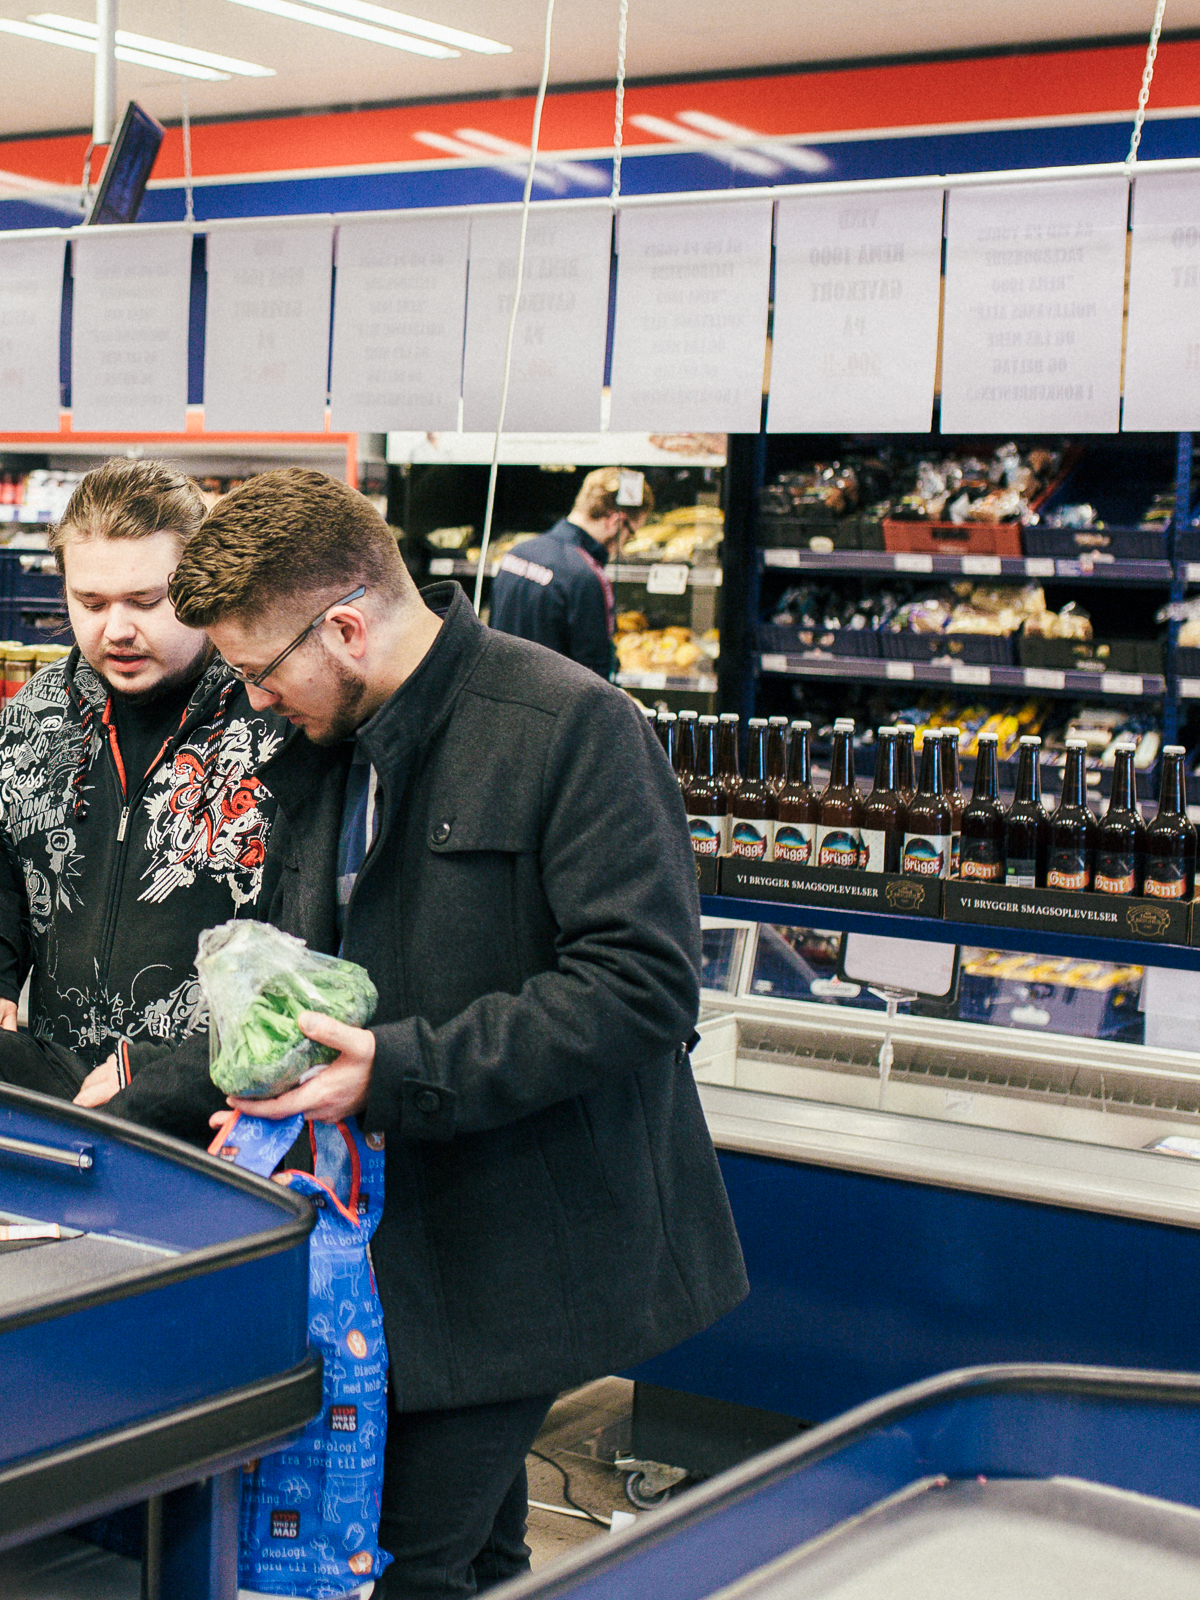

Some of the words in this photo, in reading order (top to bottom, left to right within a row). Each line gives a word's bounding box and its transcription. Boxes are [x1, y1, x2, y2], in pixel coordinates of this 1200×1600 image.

[774, 844, 809, 863] Brügge
[821, 848, 858, 868] Brügge
[904, 857, 940, 875] Brügge
[964, 862, 997, 878] Gent
[736, 874, 749, 885] VI
[749, 876, 790, 890] BRYGGER
[791, 879, 879, 898] SMAGSOPLEVELSER
[1049, 871, 1083, 888] Gent
[1095, 875, 1126, 892] Gent
[1144, 880, 1178, 897] Gent
[960, 897, 972, 908] VI
[974, 899, 1019, 913] BRYGGER
[1021, 904, 1119, 923] SMAGSOPLEVELSER
[332, 1422, 356, 1431] MAD
[307, 1455, 332, 1468] jord
[338, 1457, 355, 1469] til
[273, 1529, 297, 1538] MAD
[262, 1547, 307, 1560] Økologi
